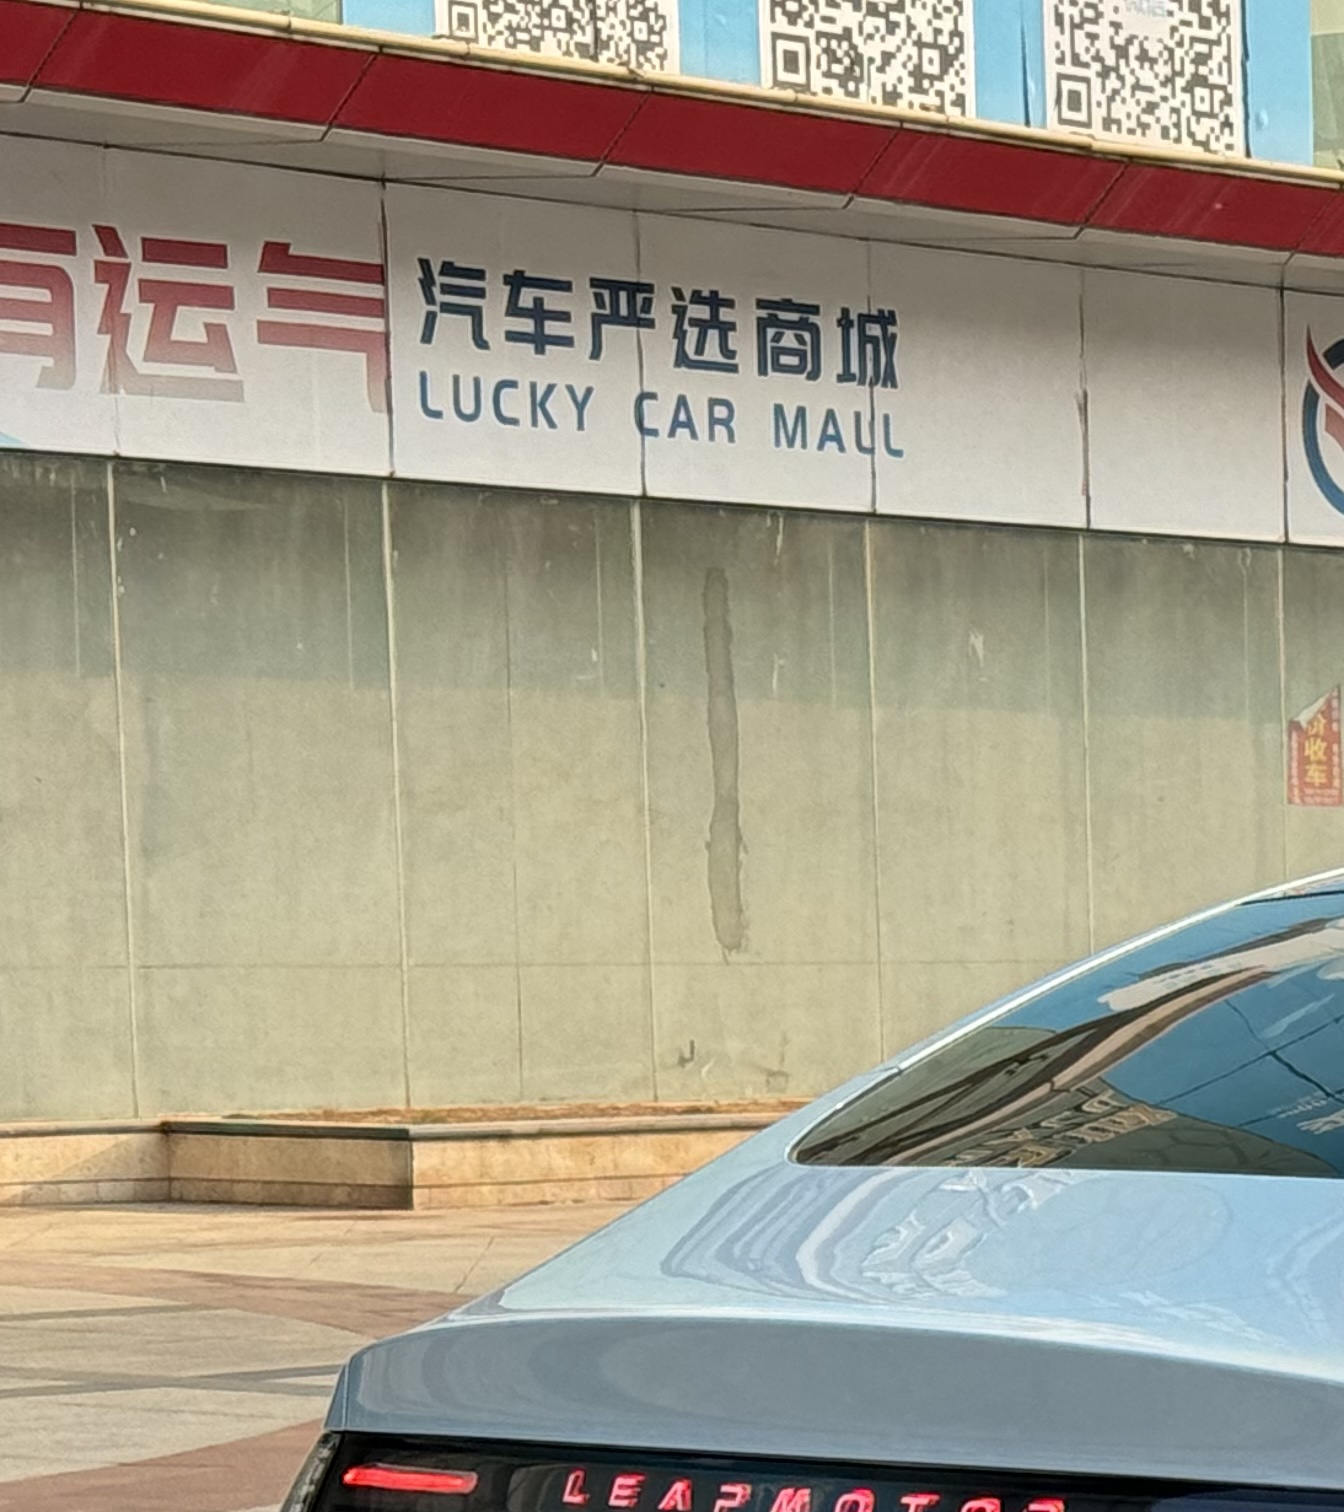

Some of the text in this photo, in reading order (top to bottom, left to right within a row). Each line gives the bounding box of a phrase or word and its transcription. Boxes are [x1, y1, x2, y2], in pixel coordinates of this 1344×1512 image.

[417, 256, 899, 390] 汽车严选商城
[418, 370, 905, 460] LUCKY CAR MALL
